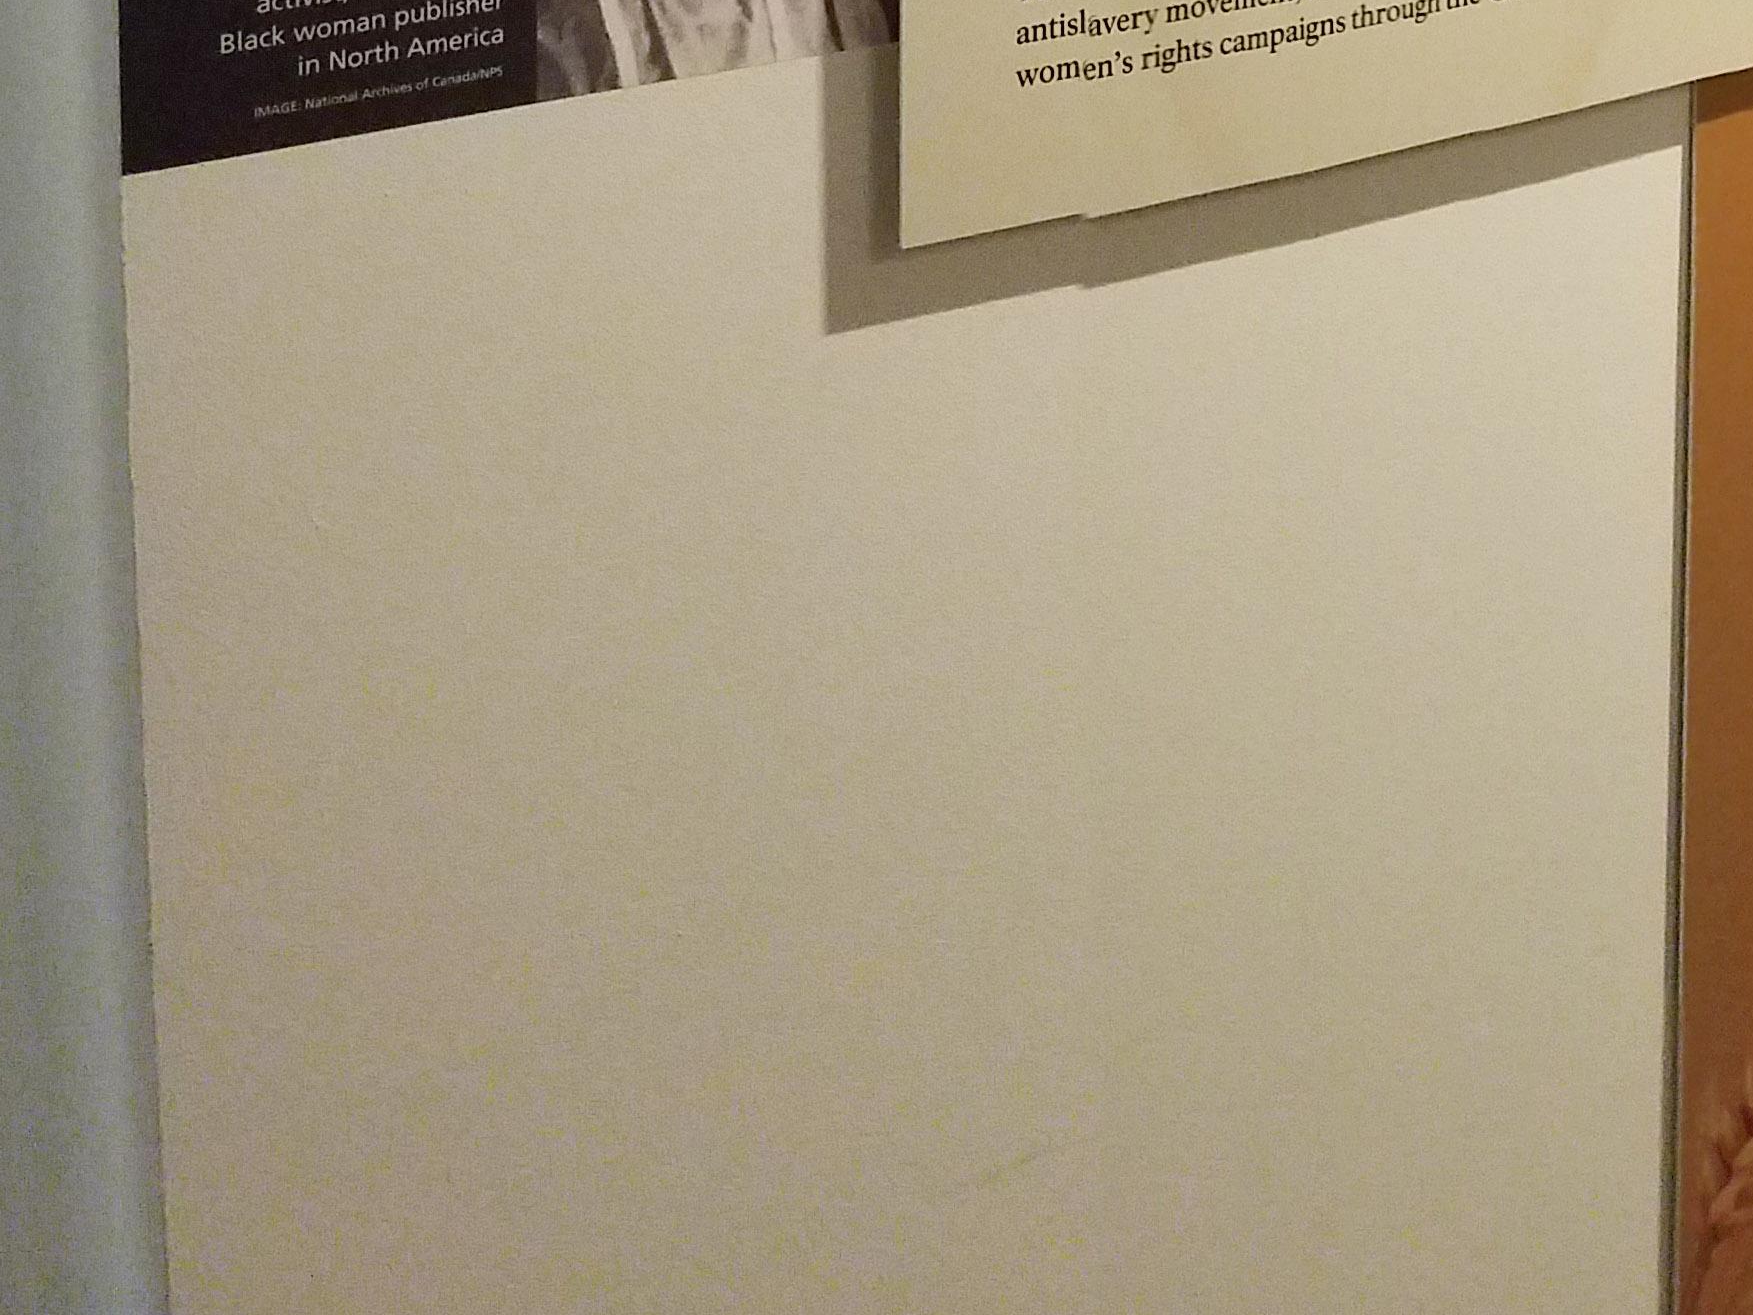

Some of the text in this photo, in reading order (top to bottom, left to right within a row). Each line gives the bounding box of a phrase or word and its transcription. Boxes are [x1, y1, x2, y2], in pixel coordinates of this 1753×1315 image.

[219, 23, 286, 55] Black
[292, 12, 386, 42] woman
[297, 25, 504, 76] in North America
[303, 89, 358, 110] National
[360, 82, 413, 100] Archives
